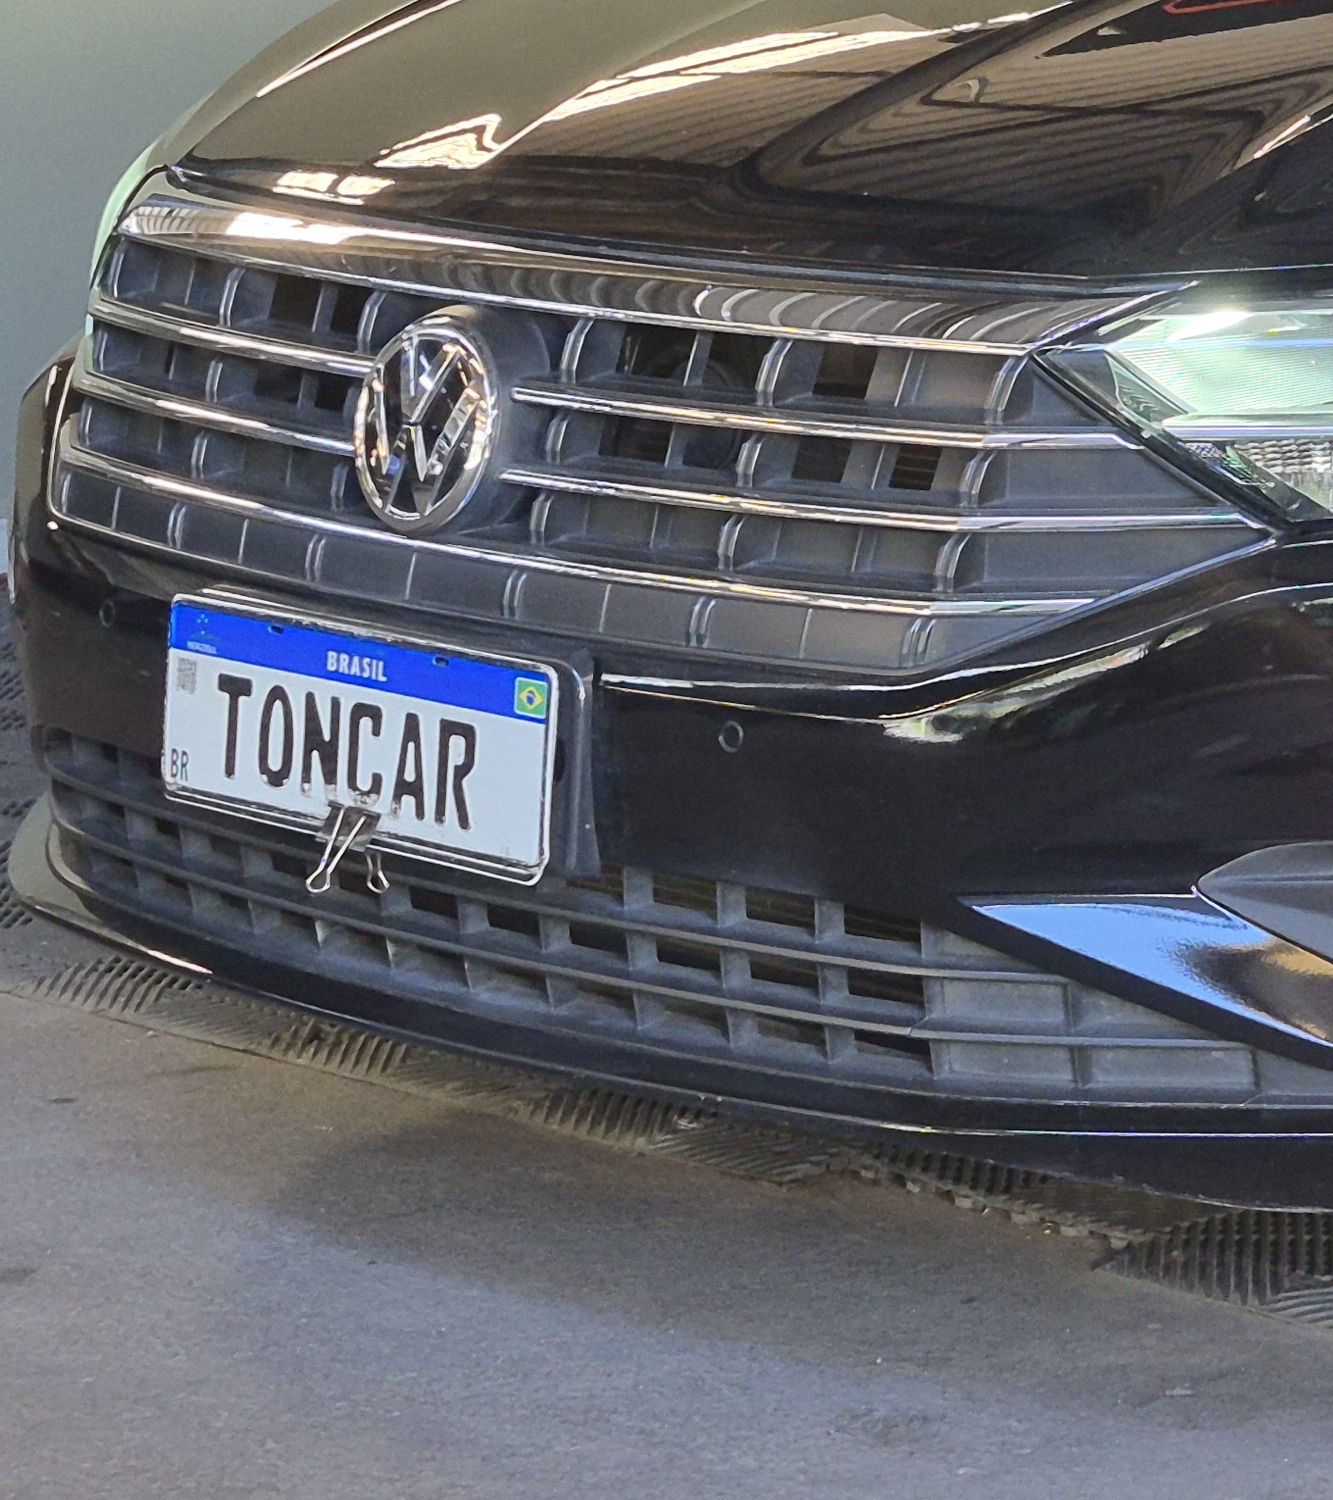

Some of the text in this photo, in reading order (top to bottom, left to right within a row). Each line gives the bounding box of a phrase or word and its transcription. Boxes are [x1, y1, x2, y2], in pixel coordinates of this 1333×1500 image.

[326, 650, 388, 682] BRASIL
[170, 748, 189, 781] BR
[217, 673, 477, 831] TONCAR
